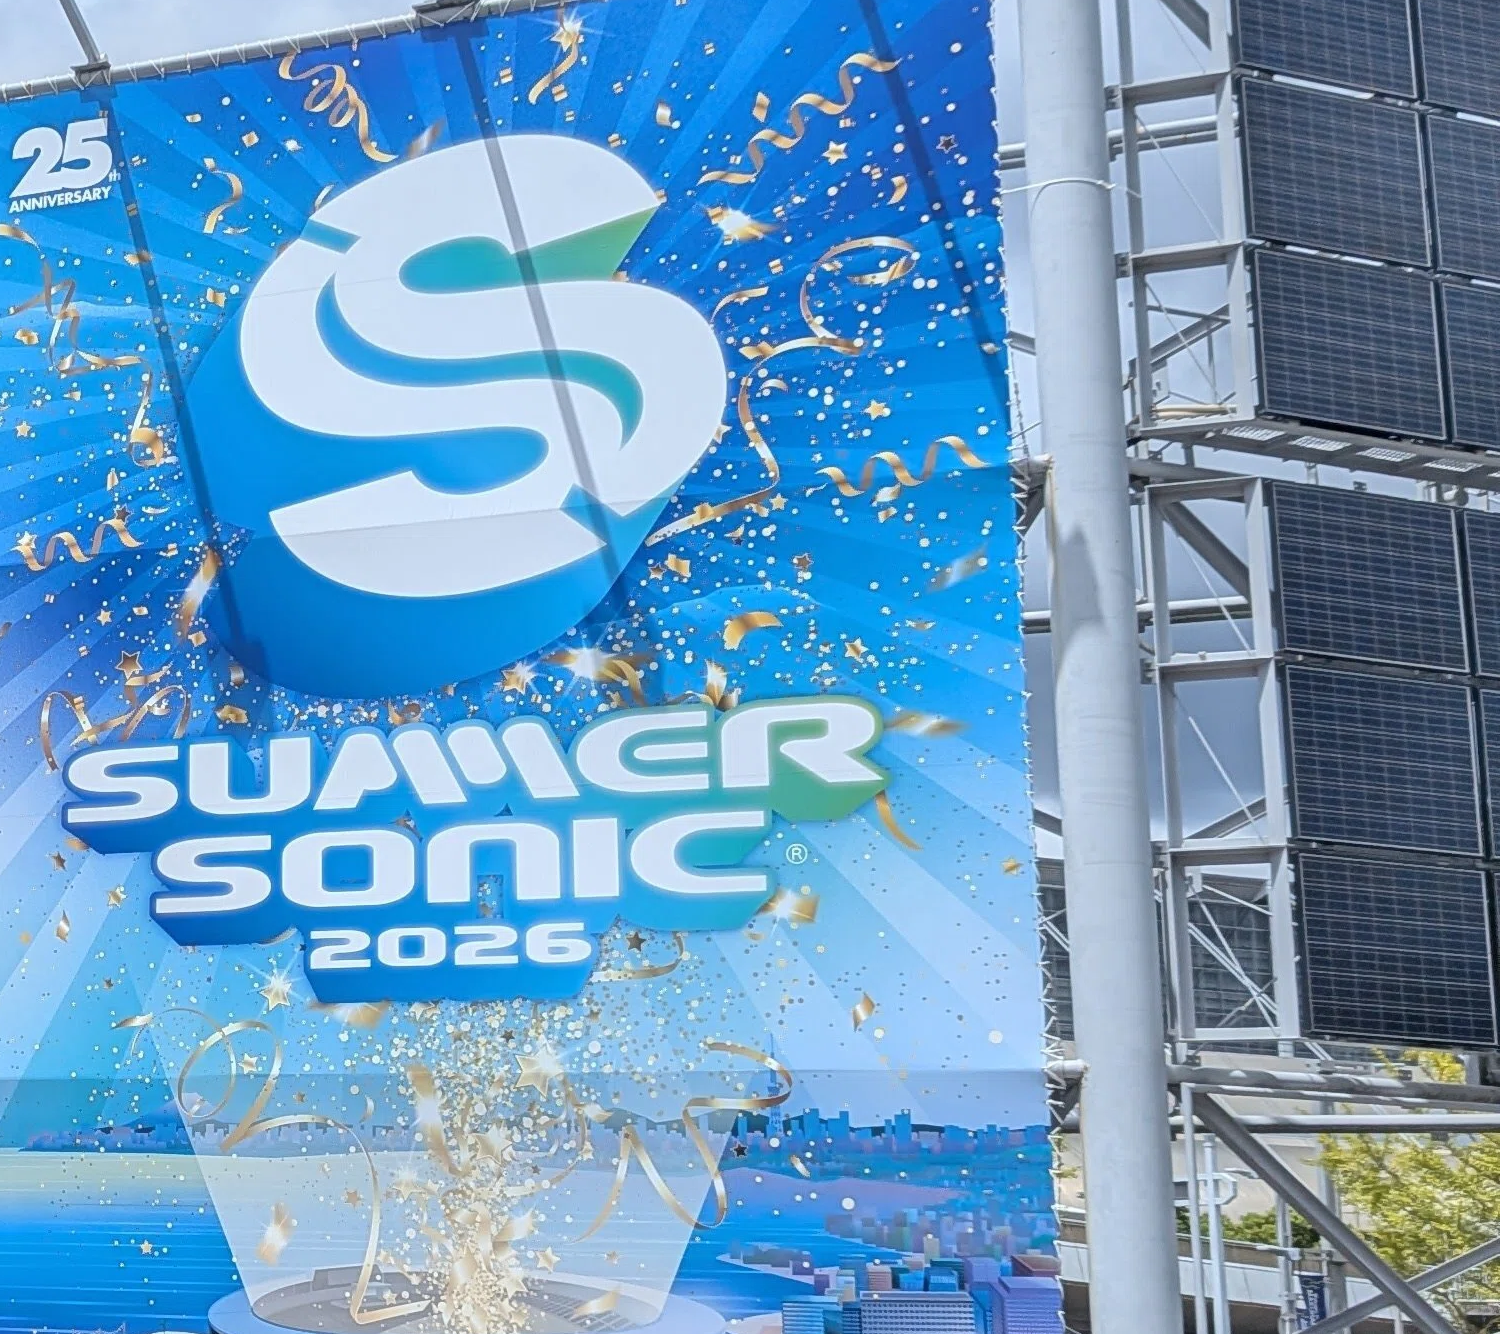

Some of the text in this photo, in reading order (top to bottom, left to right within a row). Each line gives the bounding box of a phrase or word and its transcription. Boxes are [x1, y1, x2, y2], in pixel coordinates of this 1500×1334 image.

[9, 186, 112, 214] ANNIVERSARY
[67, 700, 884, 823] SUMMER
[152, 809, 772, 917] SONIC
[309, 921, 593, 970] 2026
